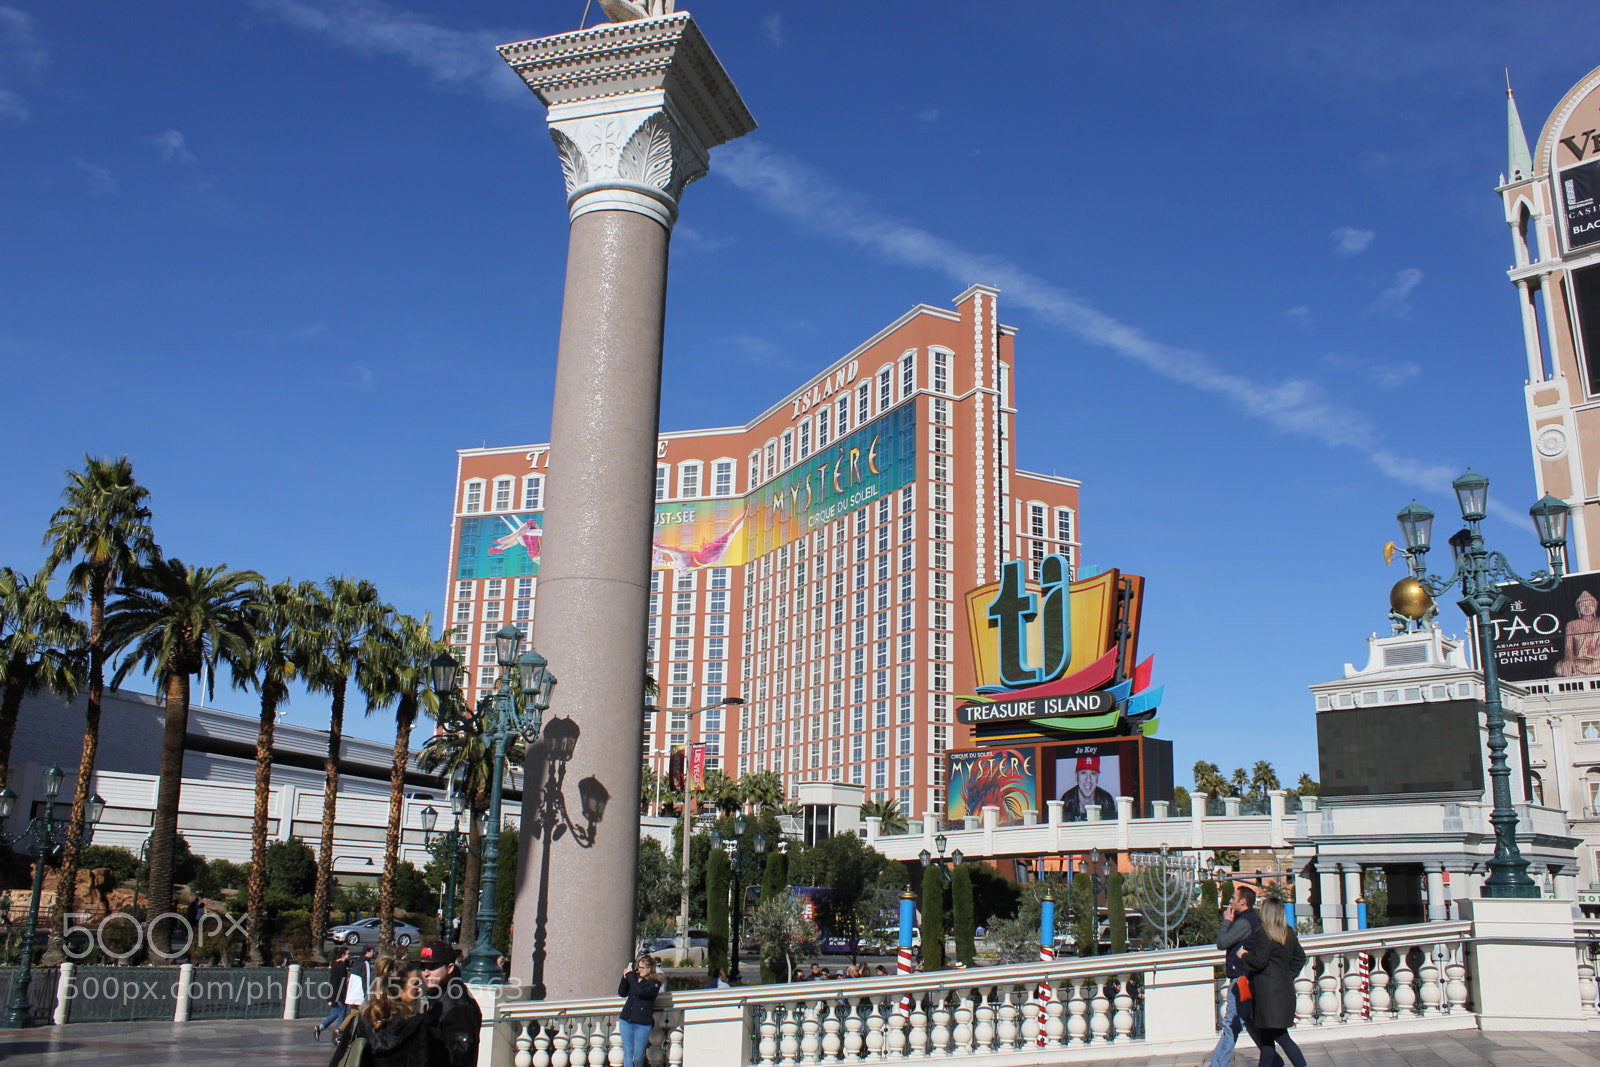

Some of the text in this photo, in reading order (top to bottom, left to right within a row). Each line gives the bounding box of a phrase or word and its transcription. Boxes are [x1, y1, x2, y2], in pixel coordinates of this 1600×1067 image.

[1568, 204, 1600, 219] CASI
[791, 359, 859, 420] ISLAND
[808, 484, 879, 528] CIRQUE DU SOLEIL
[1490, 613, 1559, 640] TAO
[1500, 654, 1548, 665] DINING
[965, 695, 1101, 721] TREASURE ISLAND
